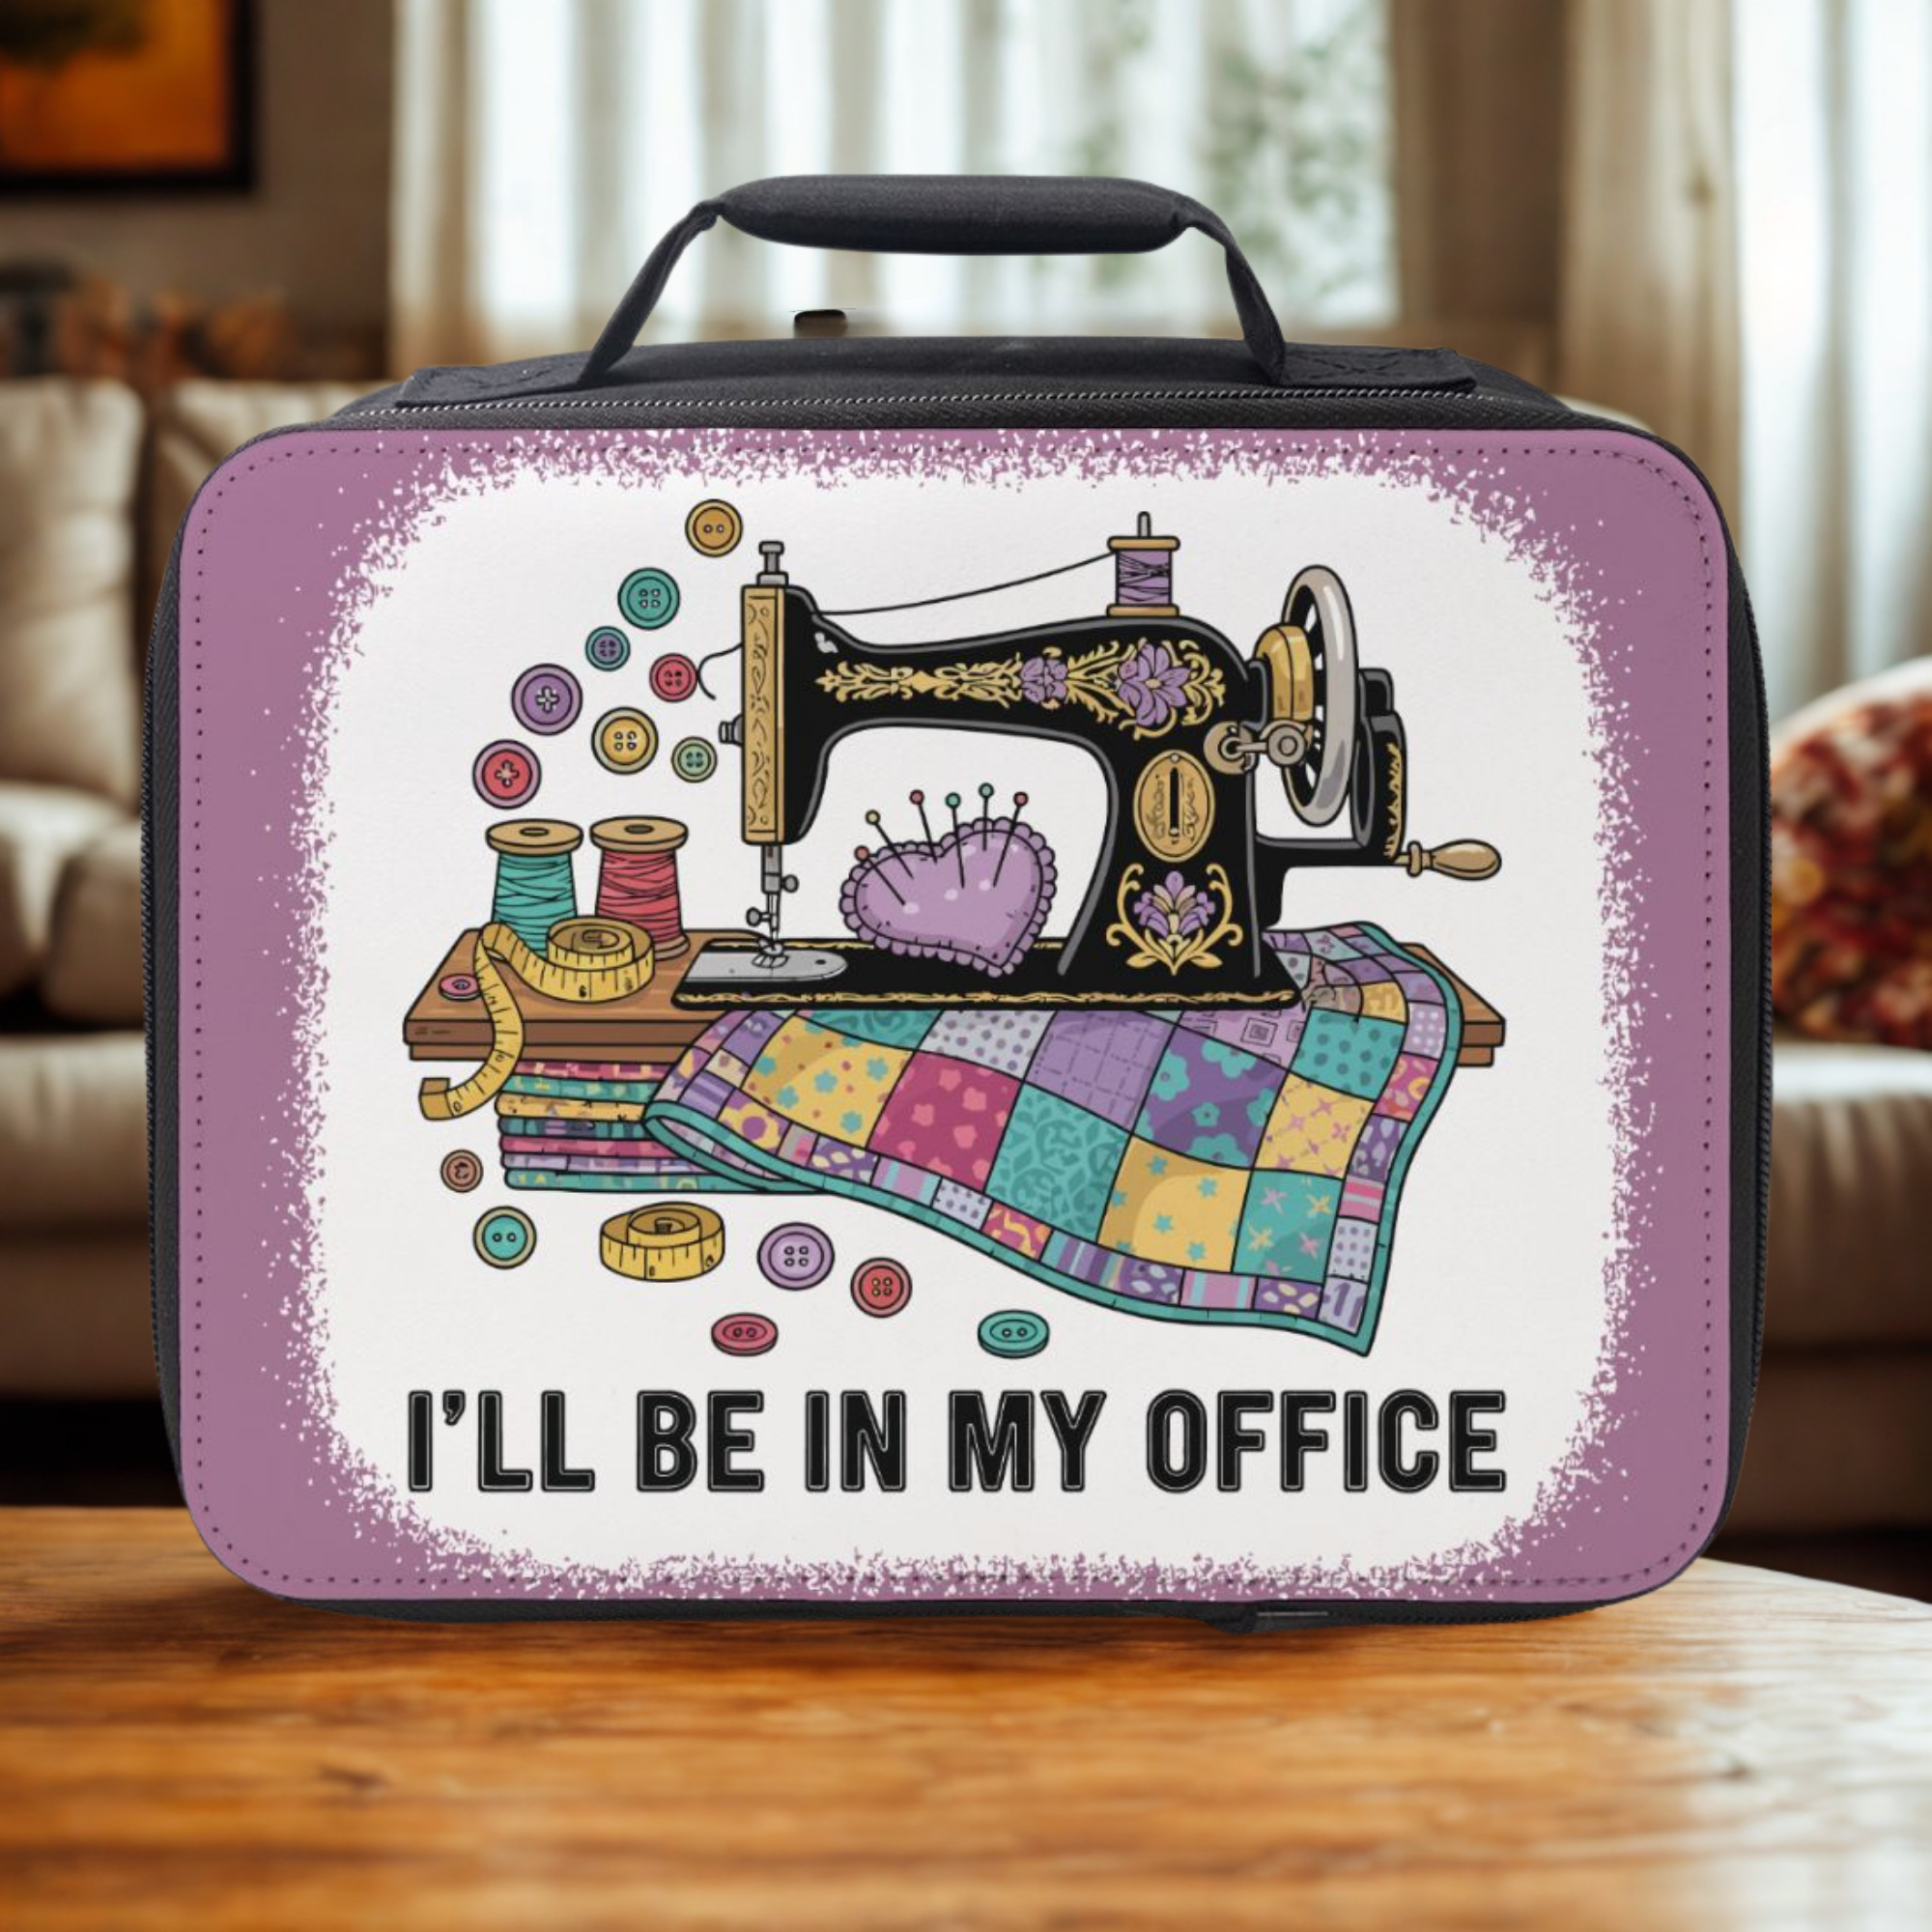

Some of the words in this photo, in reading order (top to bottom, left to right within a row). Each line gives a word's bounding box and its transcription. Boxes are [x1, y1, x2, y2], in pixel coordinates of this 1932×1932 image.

[408, 1389, 595, 1492] I’LL
[636, 1389, 764, 1492] BE
[805, 1389, 906, 1492] IN
[948, 1389, 1106, 1492] MY
[1146, 1389, 1506, 1493] OFFICE
